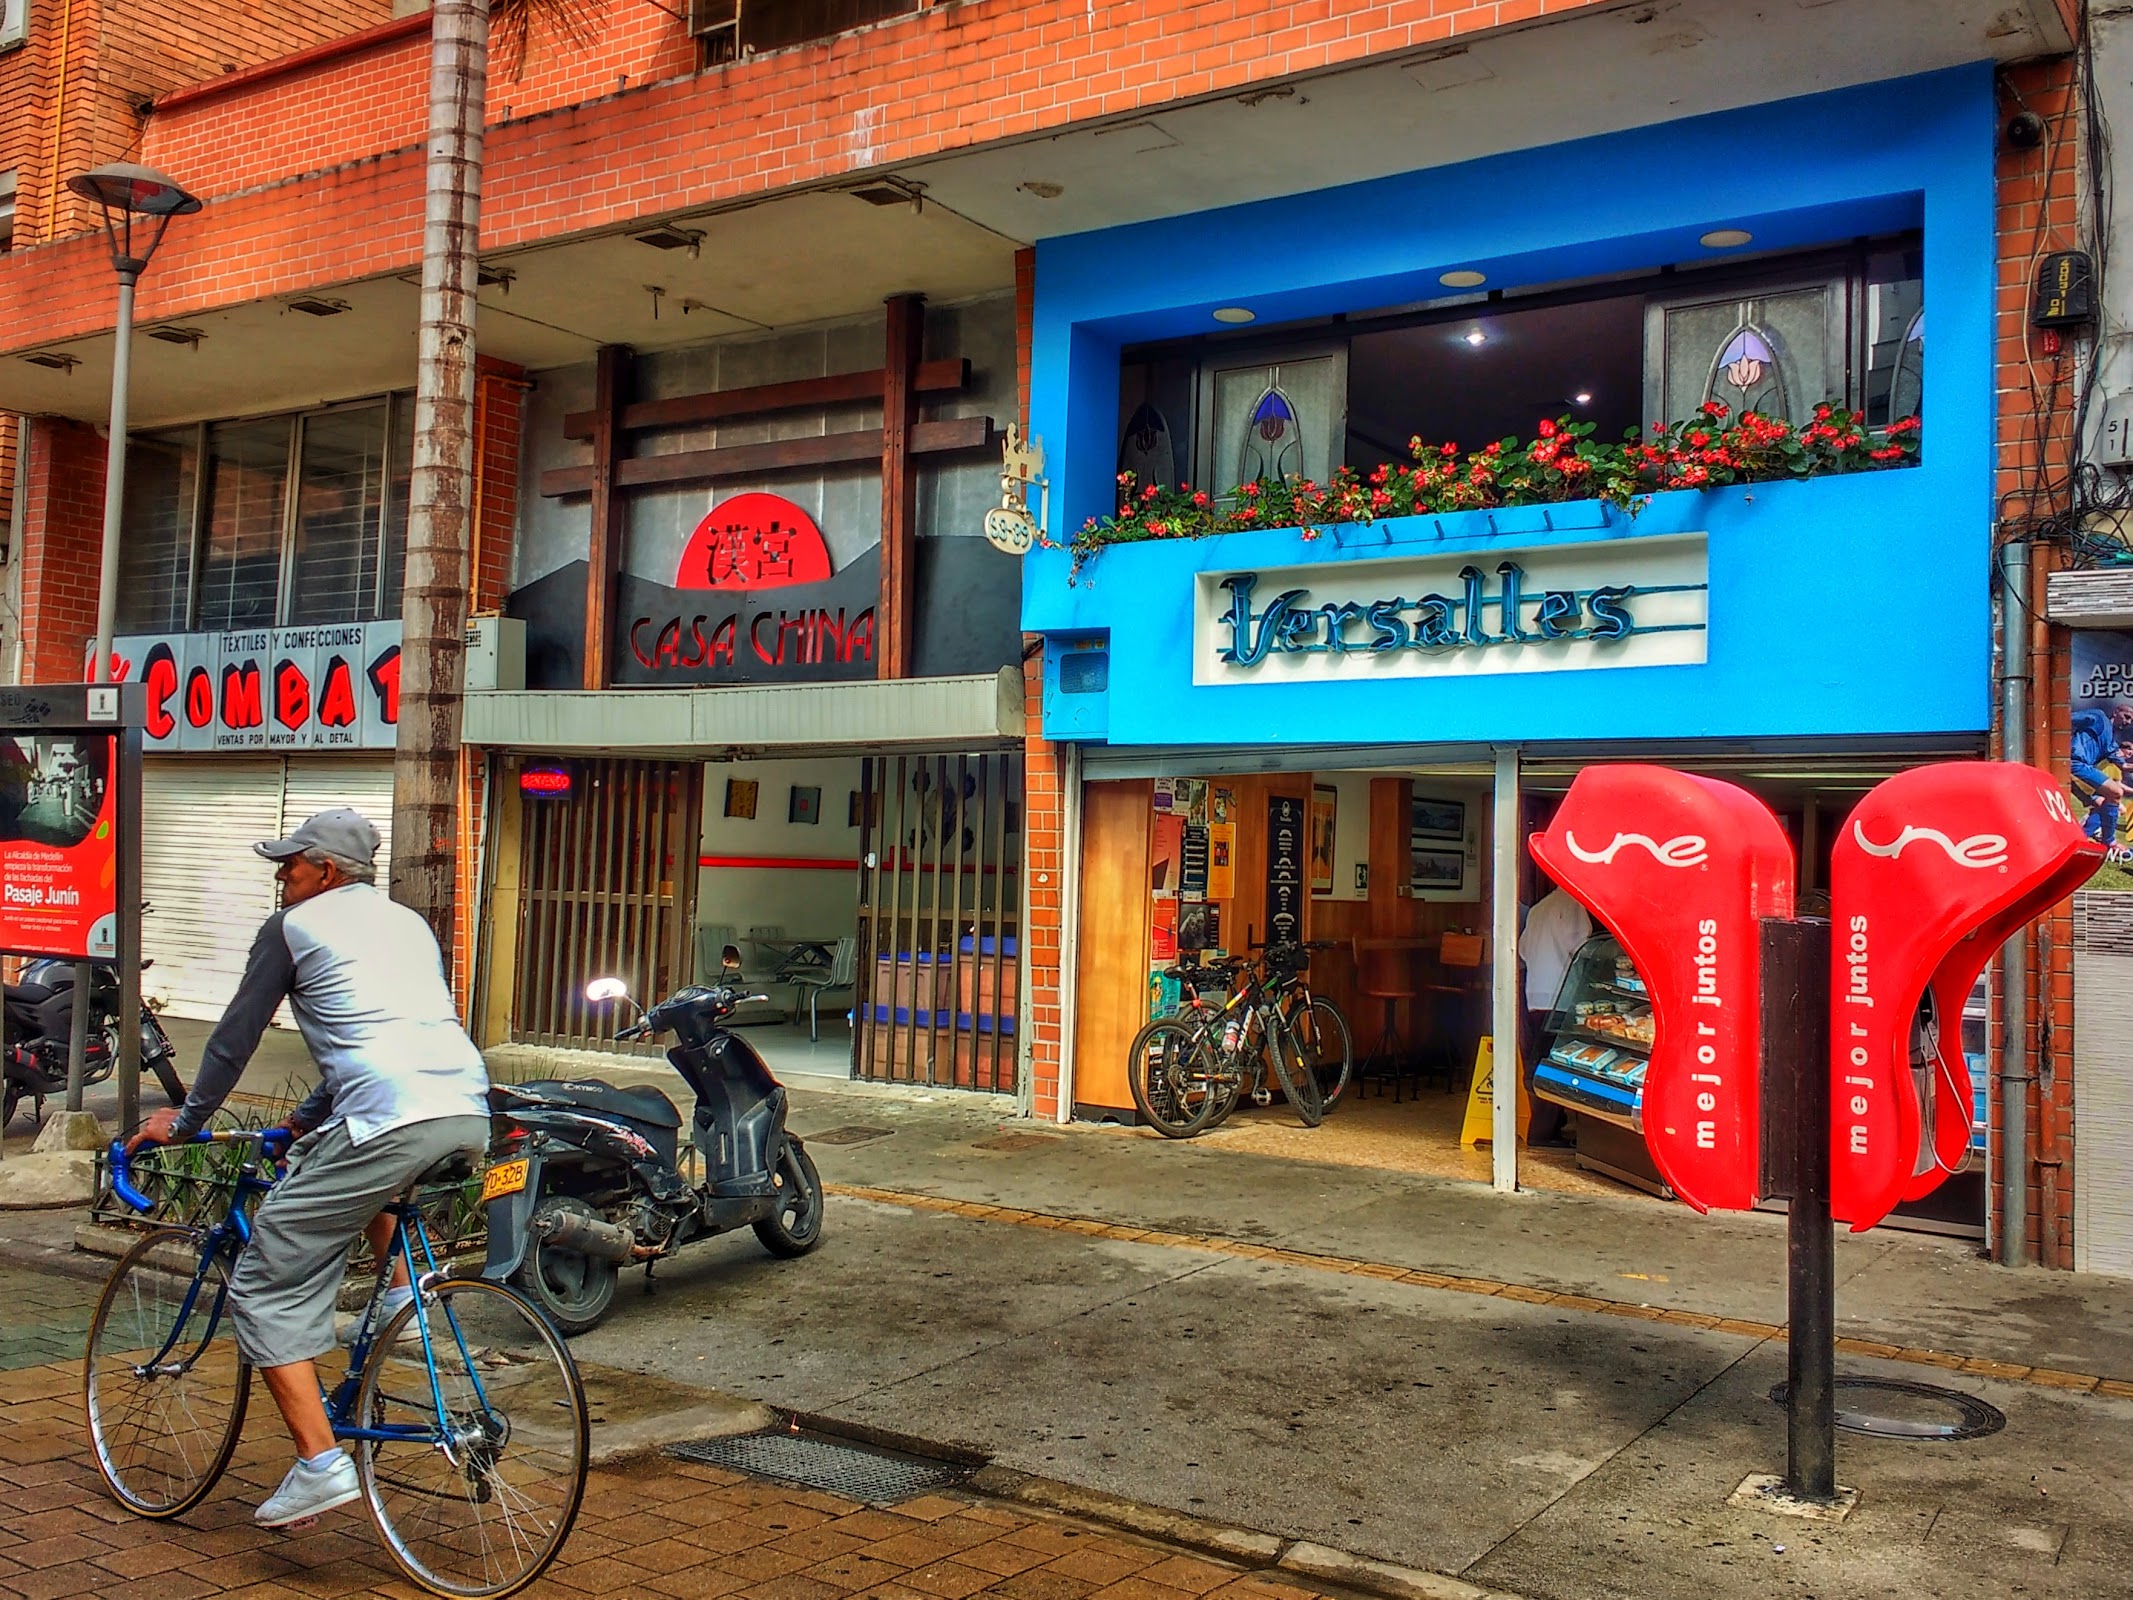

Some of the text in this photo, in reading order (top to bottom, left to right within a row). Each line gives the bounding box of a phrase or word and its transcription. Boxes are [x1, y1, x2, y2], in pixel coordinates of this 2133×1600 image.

[1218, 560, 1636, 668] Versalles
[222, 628, 362, 652] TEXTILES Y CONFECCIONES
[630, 606, 875, 669] CASA CHINA
[217, 732, 353, 745] VENTAS POR MAYOR Y AL DETAL
[1566, 830, 1708, 868] une
[1853, 819, 2009, 868] une
[4, 883, 80, 907] Pasaje Junín
[1691, 918, 1722, 1149] mejor juntos
[1845, 915, 1874, 1154] mejor juntos
[575, 1085, 603, 1093] KYMCO
